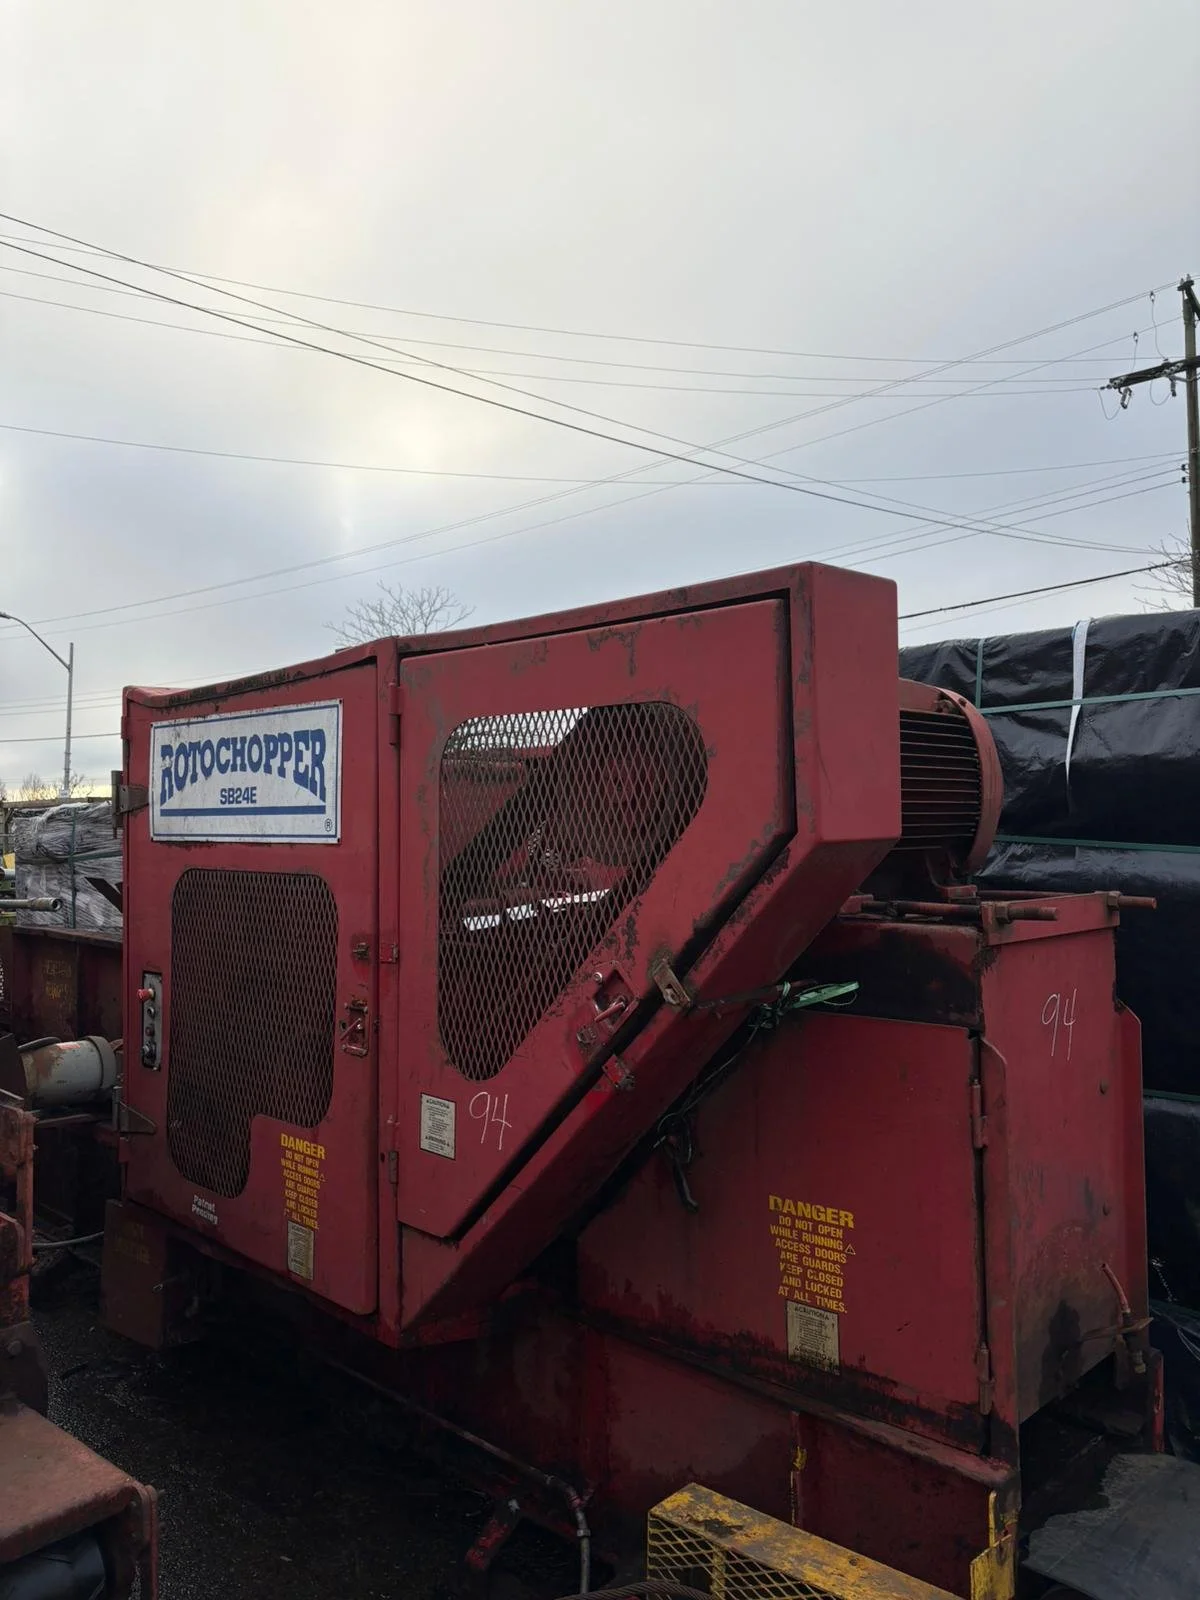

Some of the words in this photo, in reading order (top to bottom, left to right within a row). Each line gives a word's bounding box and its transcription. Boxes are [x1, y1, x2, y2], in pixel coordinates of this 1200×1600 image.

[160, 729, 326, 807] ROTOCHOPPER
[220, 787, 257, 805] SB24E
[1041, 988, 1077, 1061] 94
[469, 1091, 512, 1150] 94
[281, 1133, 325, 1160] DANGER
[285, 1150, 293, 1160] DO
[304, 1176, 321, 1190] DOORS
[285, 1190, 298, 1200] KEEP
[299, 1194, 319, 1209] CLOSED
[298, 1204, 317, 1218] LOCKED
[769, 1195, 855, 1229] DANGER
[770, 1224, 799, 1240] WHILE
[802, 1232, 844, 1251] RUNNING
[779, 1215, 792, 1227] DO
[795, 1219, 814, 1232] NOT
[818, 1224, 843, 1239] OPEN
[776, 1238, 811, 1255] ACCESS
[815, 1247, 847, 1264] DOORS
[780, 1251, 799, 1264] ARE
[803, 1256, 844, 1275] GUARDS.
[783, 1275, 802, 1288] AND
[807, 1268, 844, 1288] CLOSED
[778, 1286, 790, 1297] AT
[794, 1290, 812, 1303] ALL
[815, 1295, 848, 1314] TIMES.
